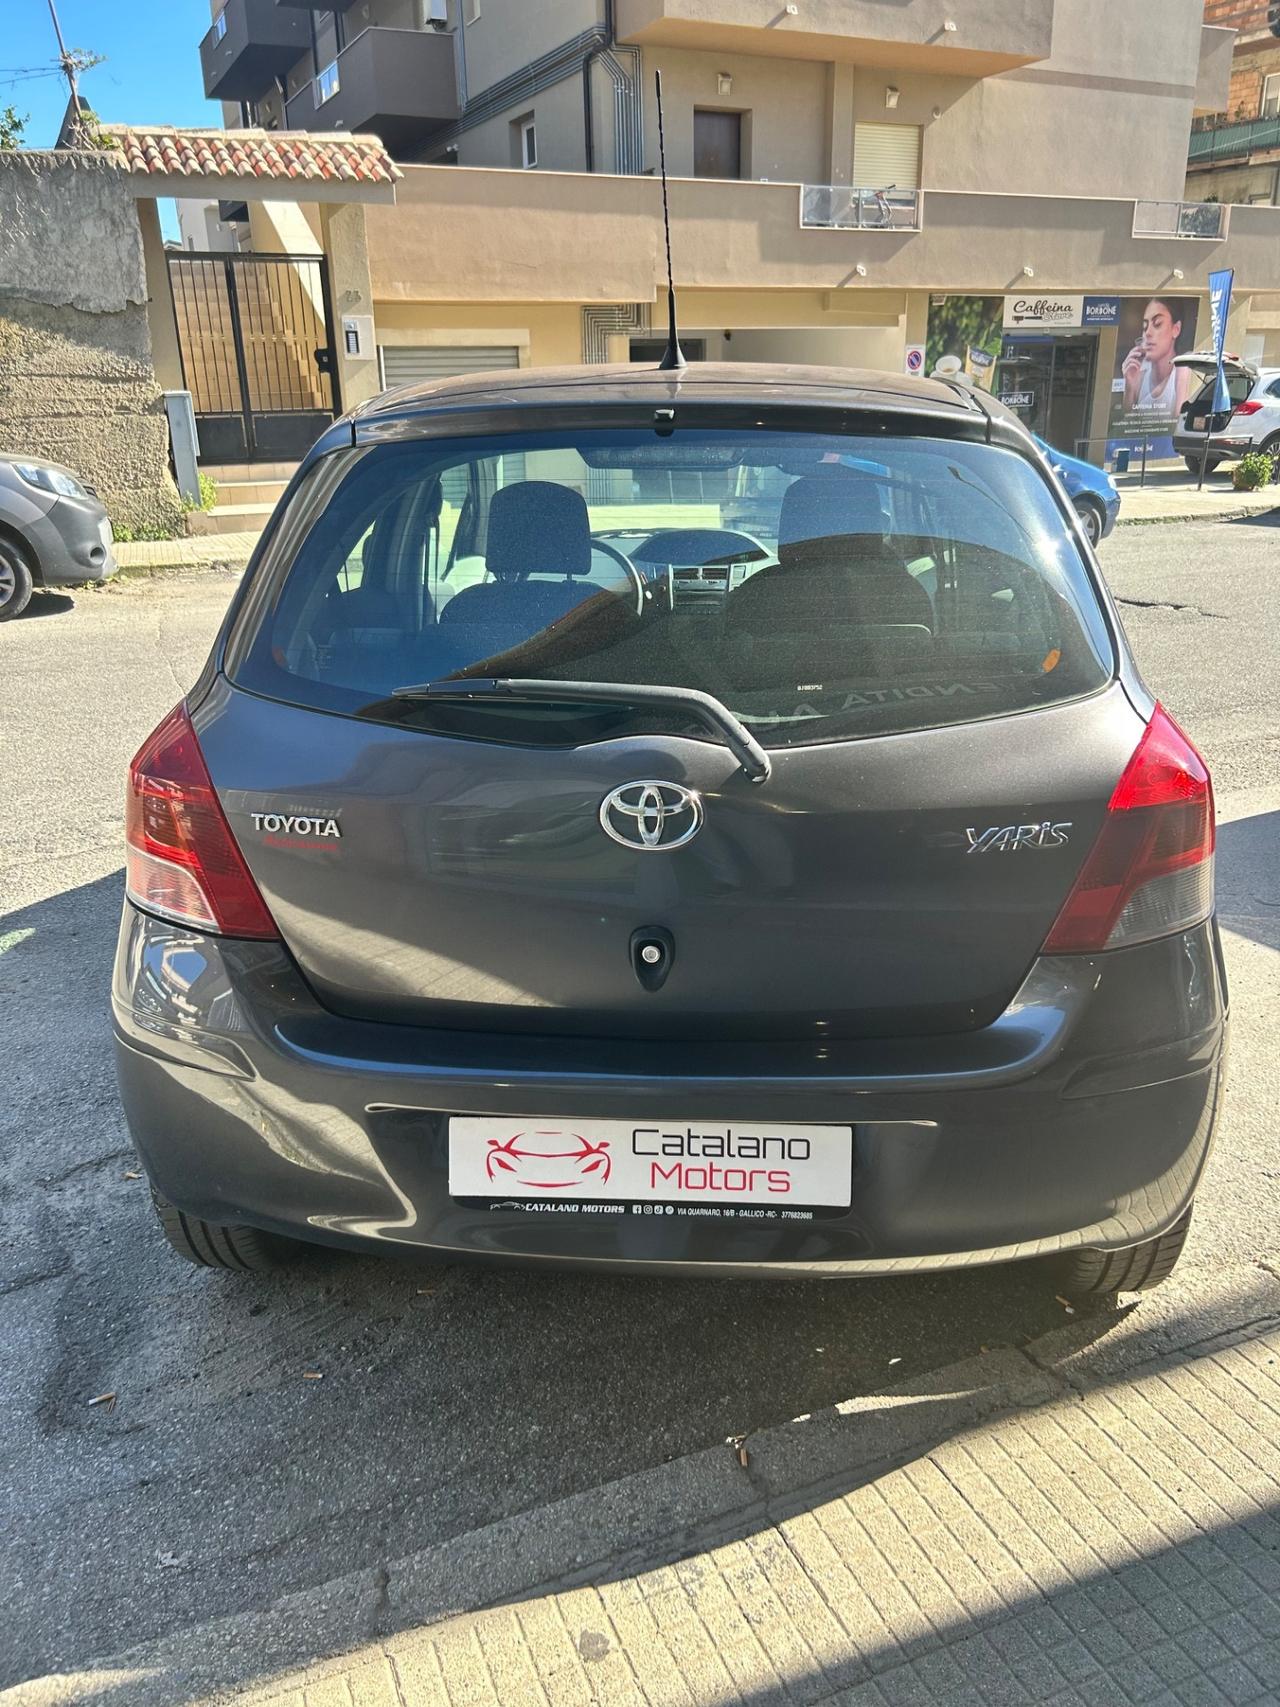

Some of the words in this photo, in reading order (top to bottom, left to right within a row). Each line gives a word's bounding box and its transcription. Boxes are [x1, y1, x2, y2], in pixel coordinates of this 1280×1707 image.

[1013, 300, 1074, 316] Caffeina
[250, 813, 341, 838] TOYOTA
[632, 1128, 811, 1161] Catalano
[650, 1162, 791, 1193] Motors
[525, 1203, 579, 1213] CATALANO
[581, 1205, 625, 1214] MOTORS
[677, 1207, 687, 1216] VIA
[739, 1209, 765, 1218] GALLICO
